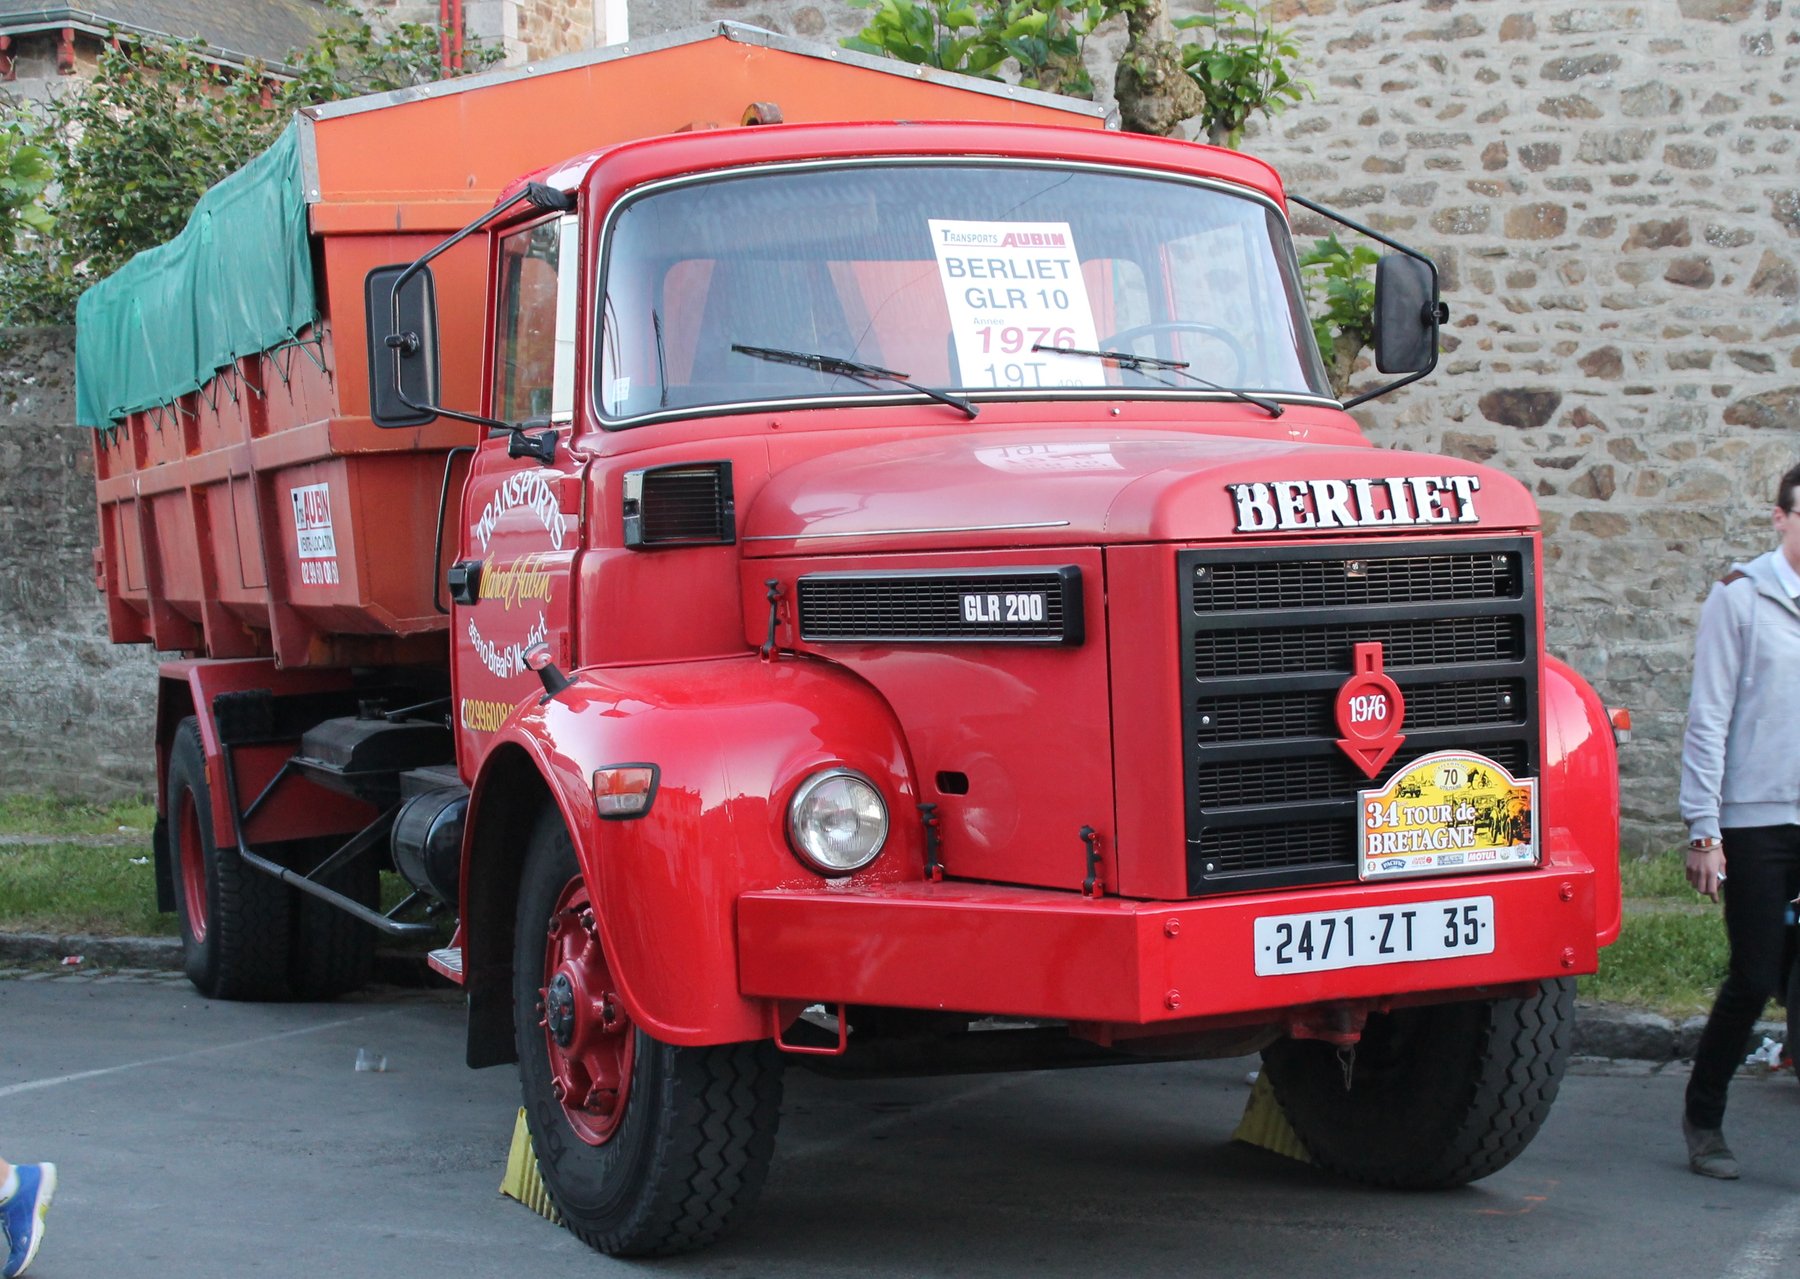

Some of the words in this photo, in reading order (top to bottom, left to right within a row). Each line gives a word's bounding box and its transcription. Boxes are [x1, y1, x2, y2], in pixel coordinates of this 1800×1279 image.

[941, 229, 998, 244] TRANSPORTS
[1001, 232, 1066, 248] AUBIN
[945, 257, 1071, 279] BERLIET
[964, 287, 1028, 310] GLR
[1036, 289, 1070, 310] 10
[975, 326, 1076, 354] 1976
[476, 470, 567, 553] TRANSPORTS
[1225, 475, 1480, 533] BERLIET
[479, 551, 523, 611] Marcel
[964, 594, 1001, 623] GLR
[1005, 593, 1043, 622] 200
[468, 617, 488, 665] 35310
[1348, 694, 1387, 723] 1976
[1443, 768, 1458, 786] 70
[1367, 802, 1399, 829] 34
[1403, 805, 1453, 826] TOUR
[1456, 802, 1476, 821] de
[1367, 826, 1476, 855] BRETAGNE
[1468, 851, 1496, 861] MOTUL
[1276, 915, 1354, 965] 2471
[1378, 911, 1416, 954] ZT
[1443, 905, 1479, 948] 35
